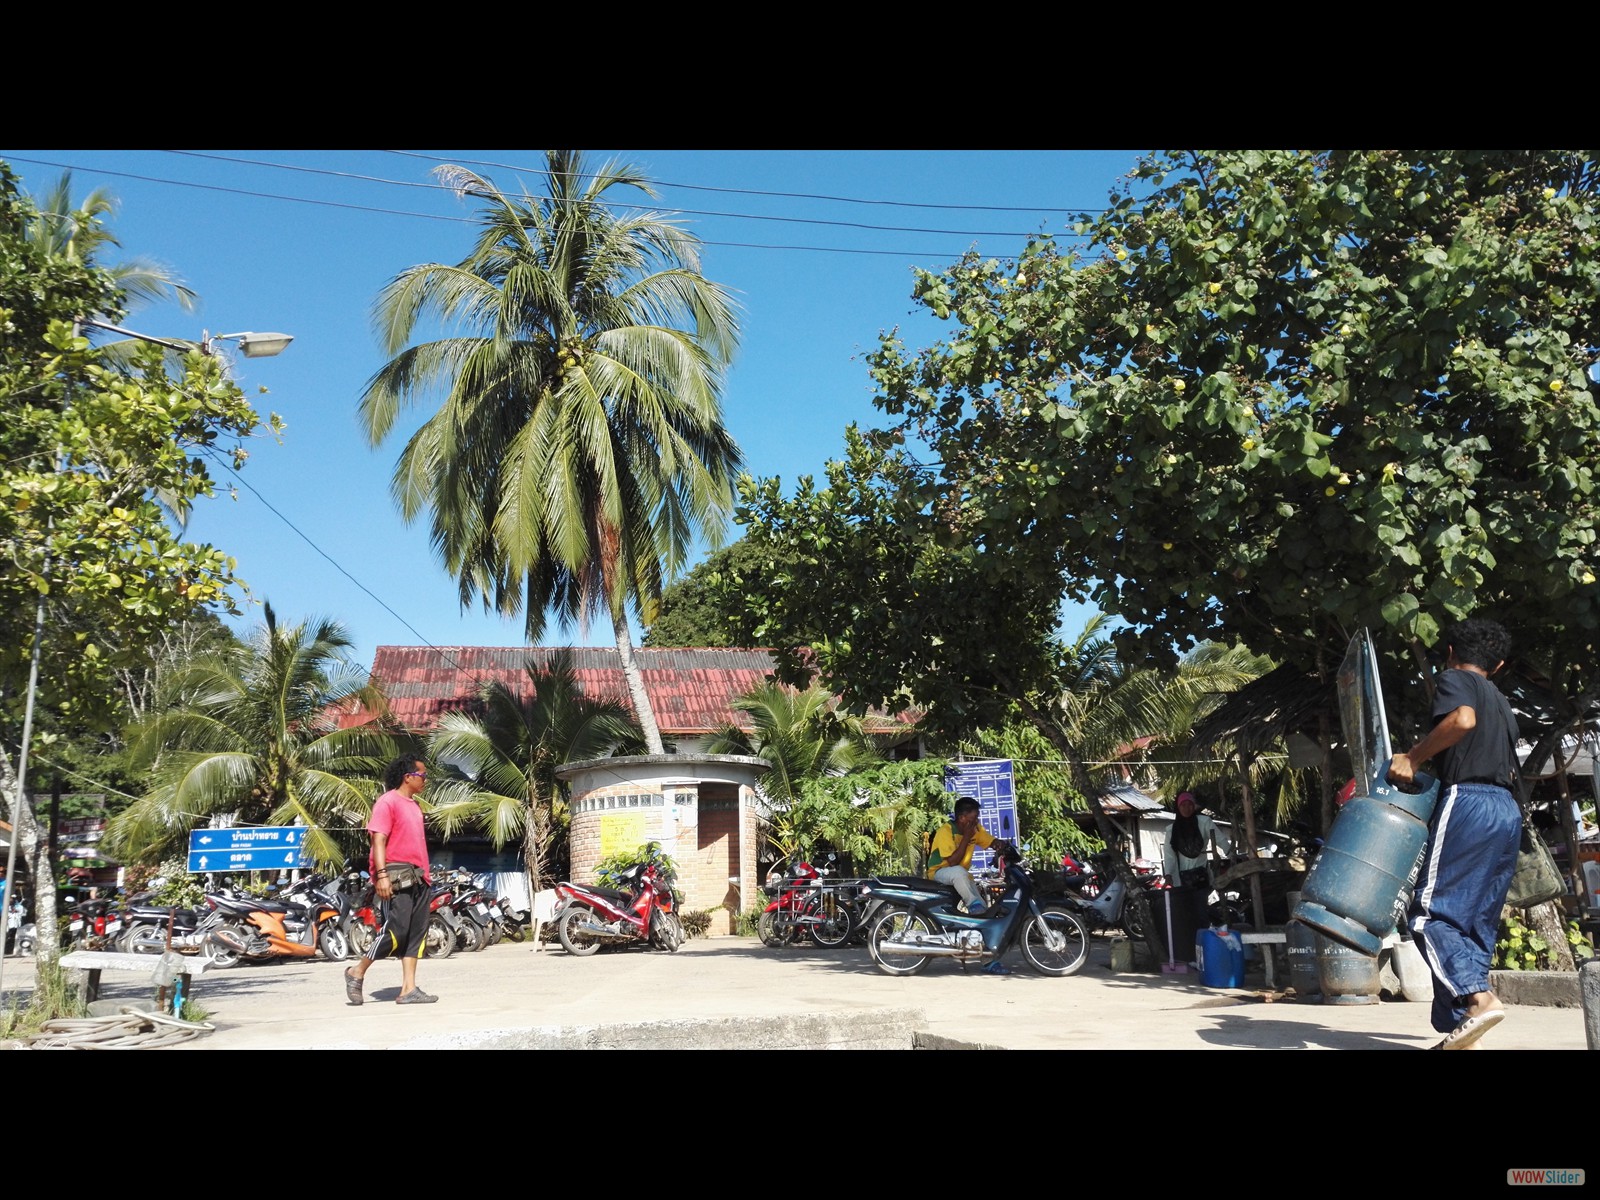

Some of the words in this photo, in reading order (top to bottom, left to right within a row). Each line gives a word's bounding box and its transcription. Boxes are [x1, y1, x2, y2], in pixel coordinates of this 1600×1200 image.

[1376, 786, 1390, 796] 16.1
[285, 831, 295, 843] 4
[284, 851, 294, 864] 4
